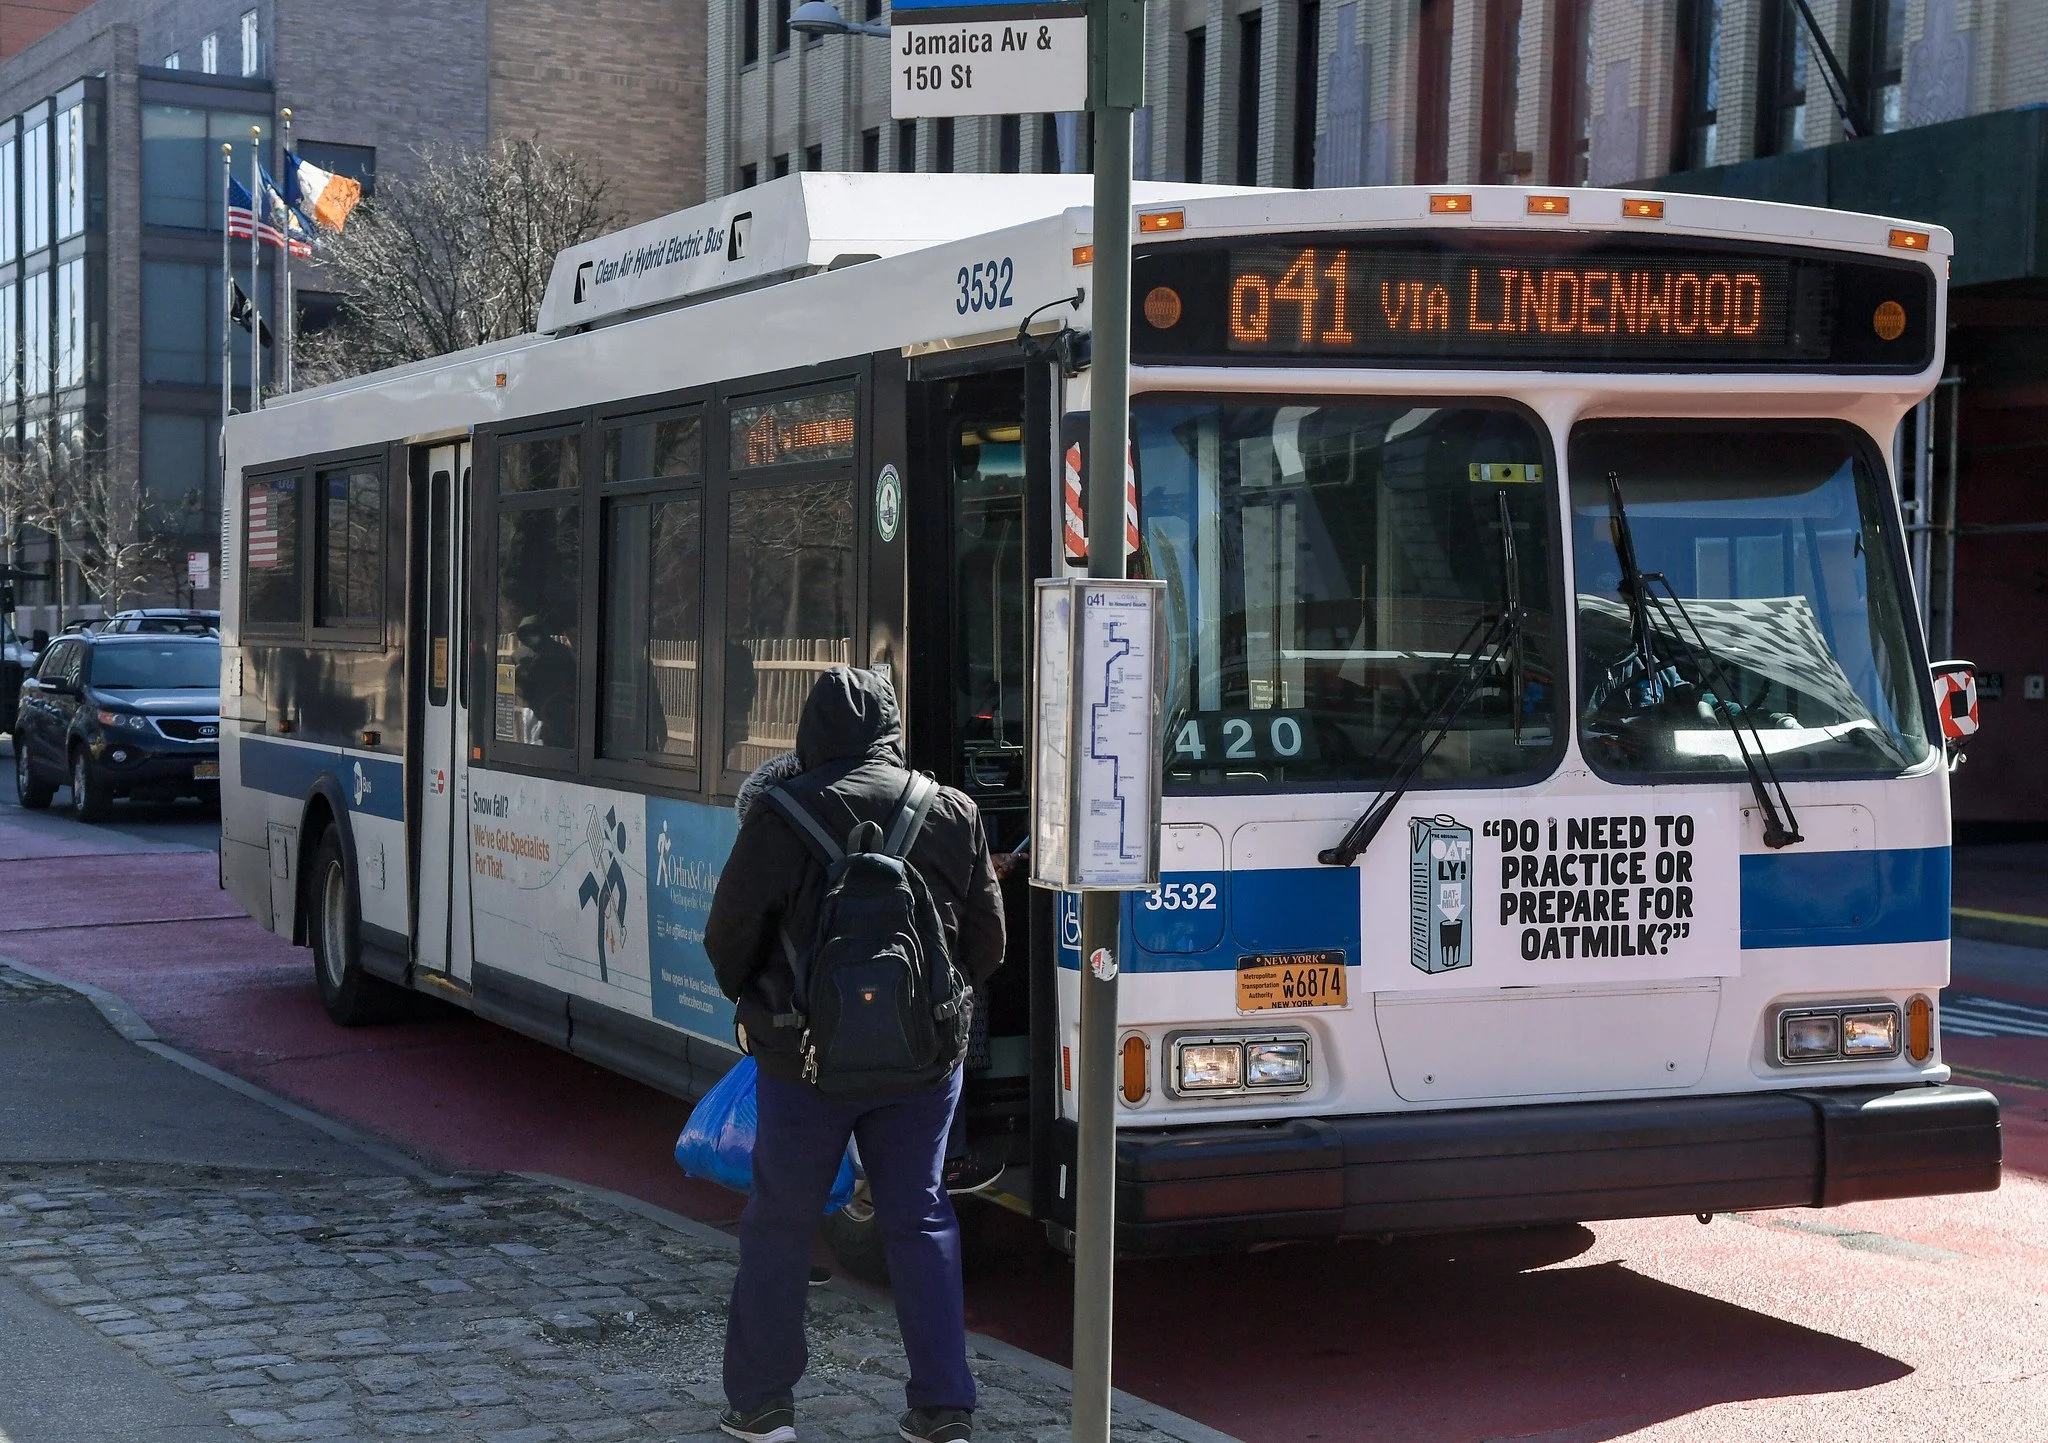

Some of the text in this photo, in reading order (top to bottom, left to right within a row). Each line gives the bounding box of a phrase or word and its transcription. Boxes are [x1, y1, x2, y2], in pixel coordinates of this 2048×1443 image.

[902, 25, 1052, 56] Jamaica Av &
[902, 63, 972, 90] 150 St
[595, 226, 725, 286] Clean Air Hybrid Electric Bus
[956, 256, 1014, 315] 3532
[1231, 248, 1762, 343] Q41 VIA LINDENWOOD
[362, 776, 372, 793] Bus
[473, 791, 492, 816] Snow
[493, 793, 509, 819] fall?
[473, 824, 550, 862] We've Got Specialists
[1547, 816, 1558, 852] I
[1567, 815, 1647, 850] NEED
[1655, 815, 1694, 847] TO
[475, 852, 486, 875] For
[1438, 860, 1466, 881] LY!
[1501, 851, 1693, 889] PRACTICE OR
[1145, 882, 1217, 910] 3532
[1441, 899, 1460, 909] MILK
[1500, 886, 1694, 926] PREPARE FOR
[1264, 954, 1320, 966] NEW YORK
[1241, 982, 1280, 990] Transportation
[1243, 972, 1277, 980] Metropolitan
[1248, 991, 1274, 999] Authority
[1271, 1001, 1290, 1009] NEW
